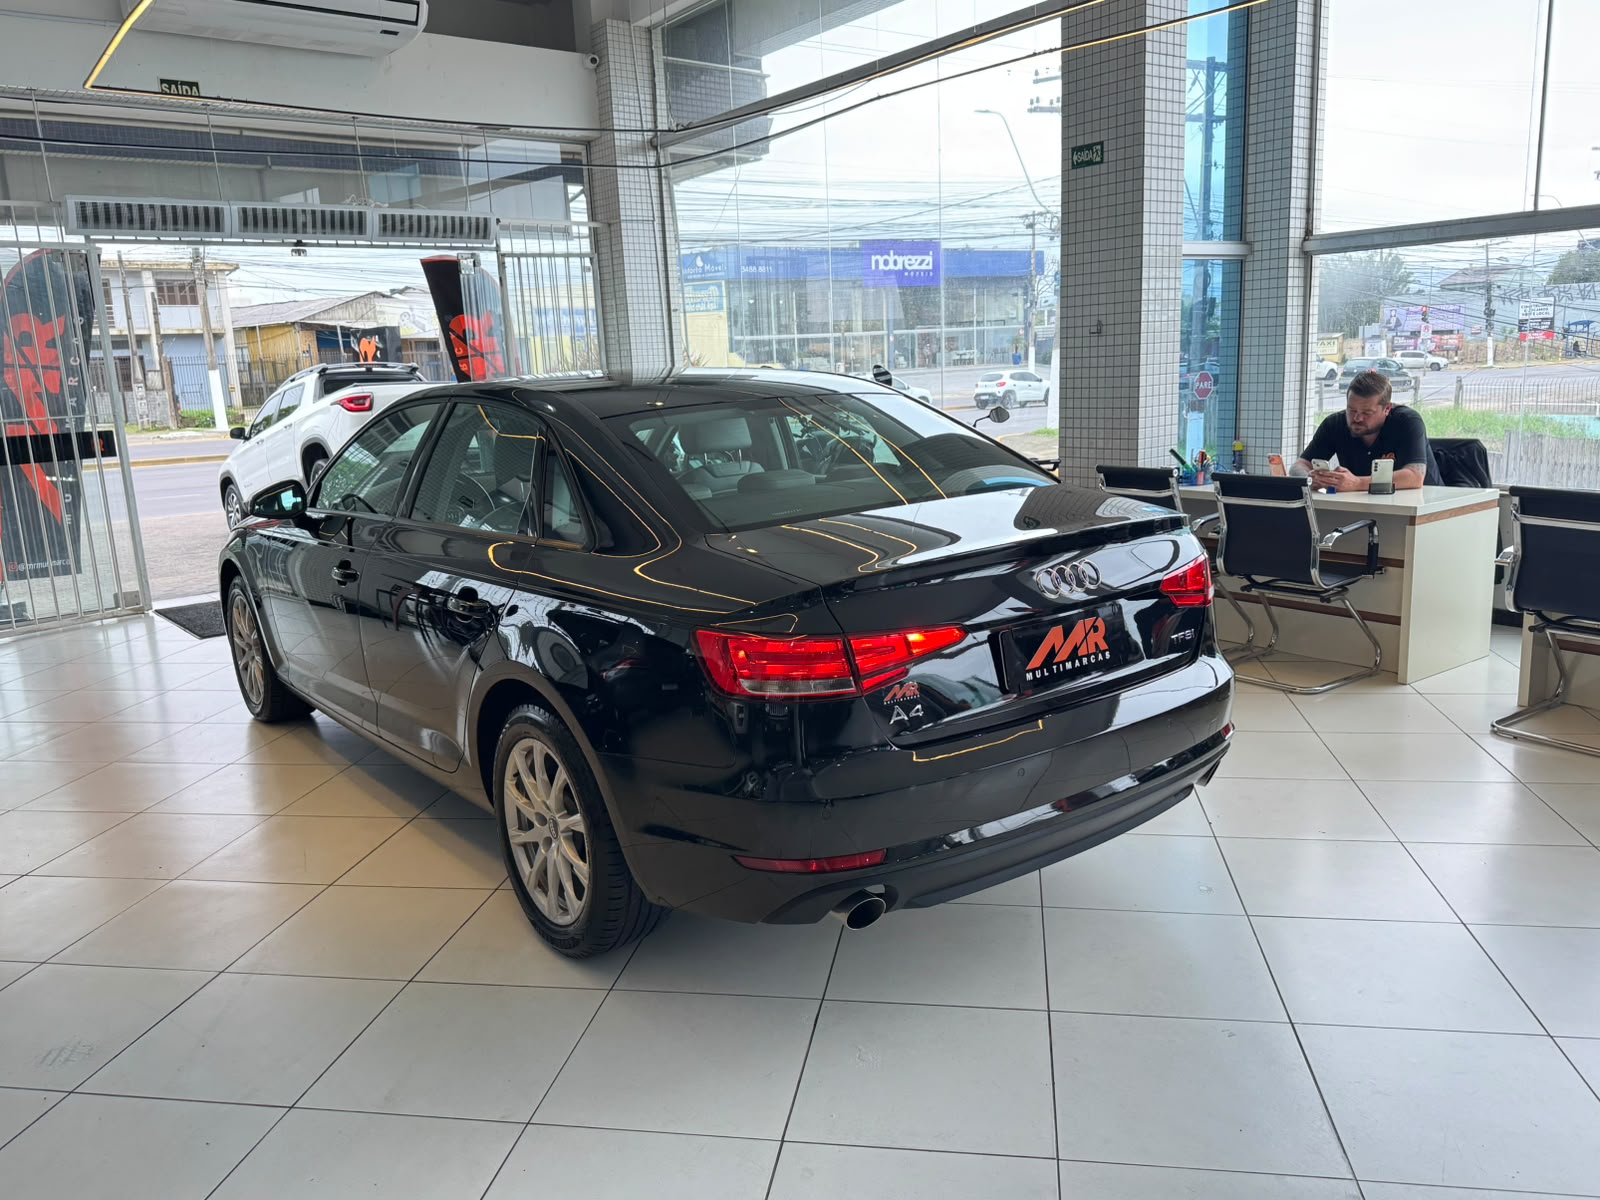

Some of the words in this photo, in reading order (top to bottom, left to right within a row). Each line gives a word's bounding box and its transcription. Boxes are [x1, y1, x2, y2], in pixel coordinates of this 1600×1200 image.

[161, 81, 199, 96] SAÍDA
[871, 249, 933, 271] nobrezzi
[1195, 380, 1212, 390] PARE
[1170, 628, 1195, 645] TFSI
[1025, 651, 1111, 682] MULTIMARCAS
[889, 704, 924, 725] A4
